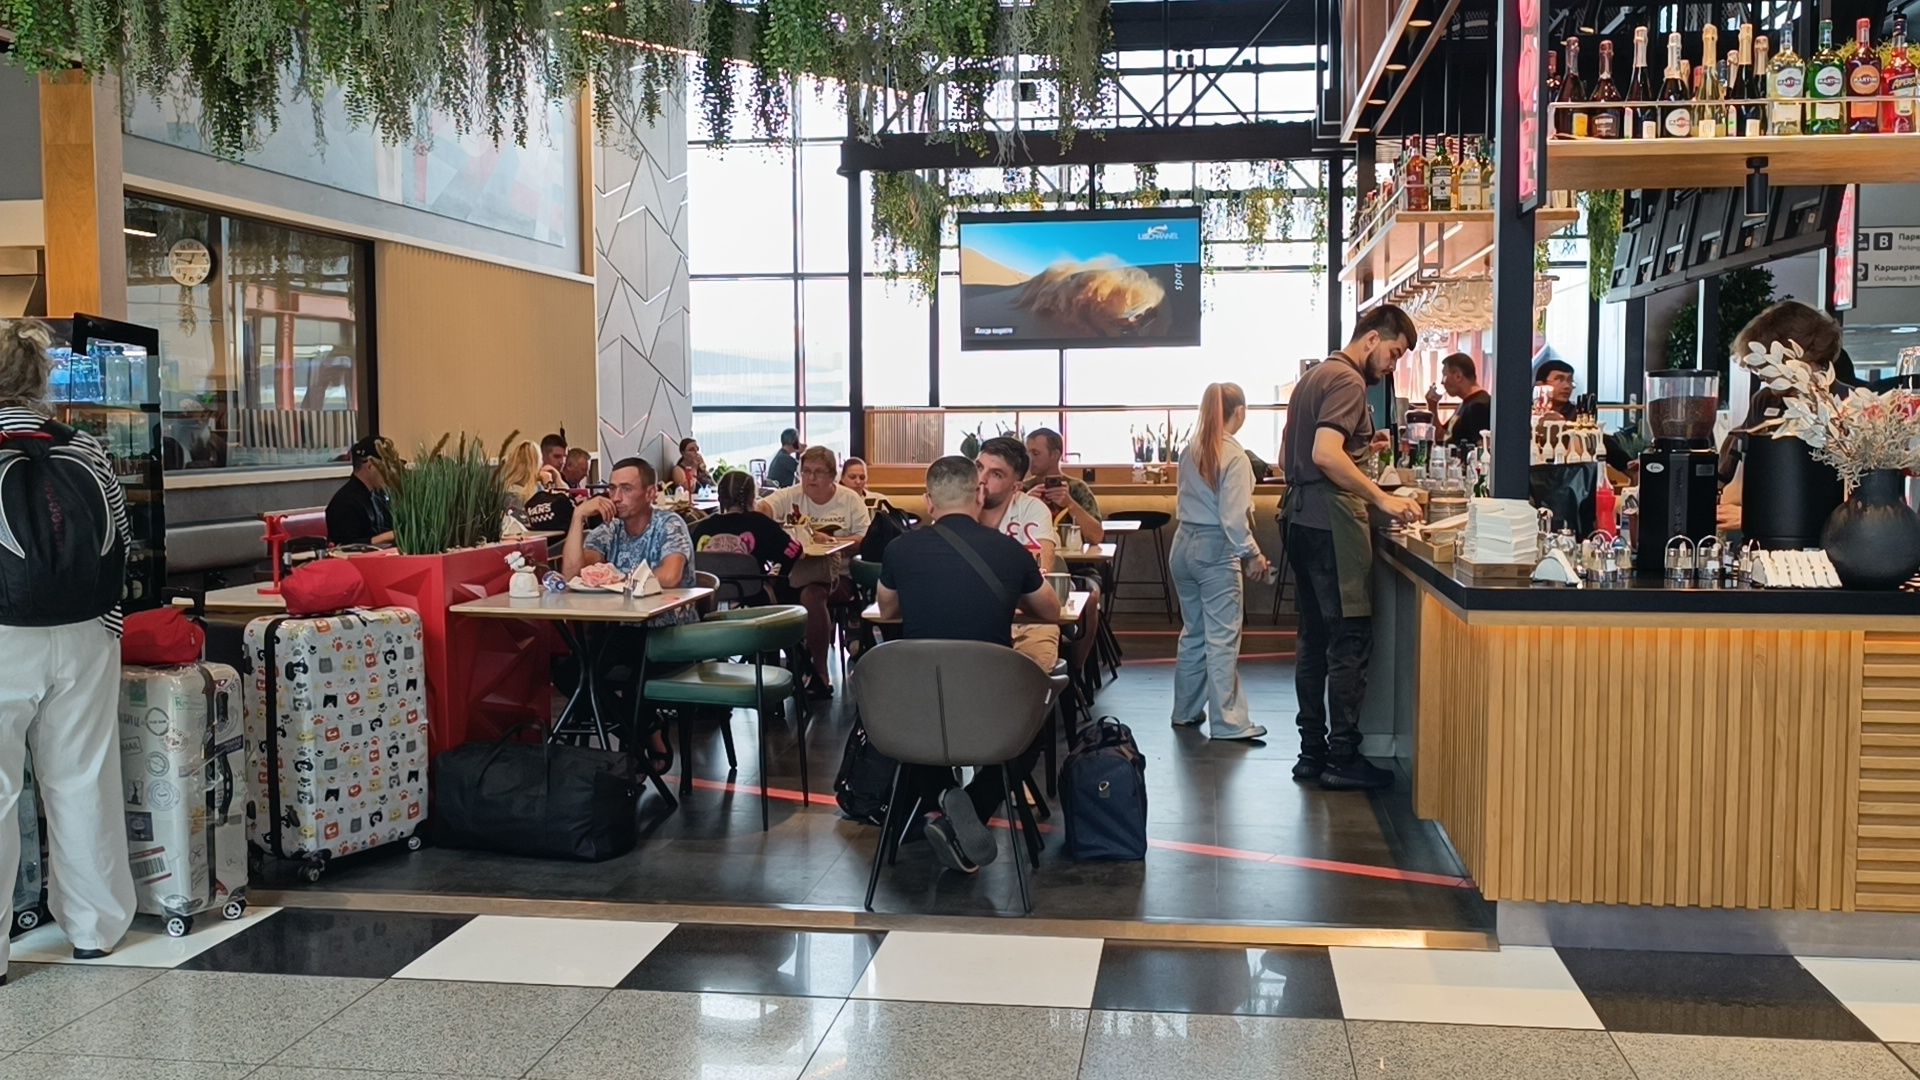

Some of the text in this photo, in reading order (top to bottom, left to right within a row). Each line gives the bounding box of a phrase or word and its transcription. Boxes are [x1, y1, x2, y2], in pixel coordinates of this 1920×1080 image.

[1879, 235, 1889, 248] B
[1174, 263, 1184, 291] sport
[527, 502, 552, 516] VANS
